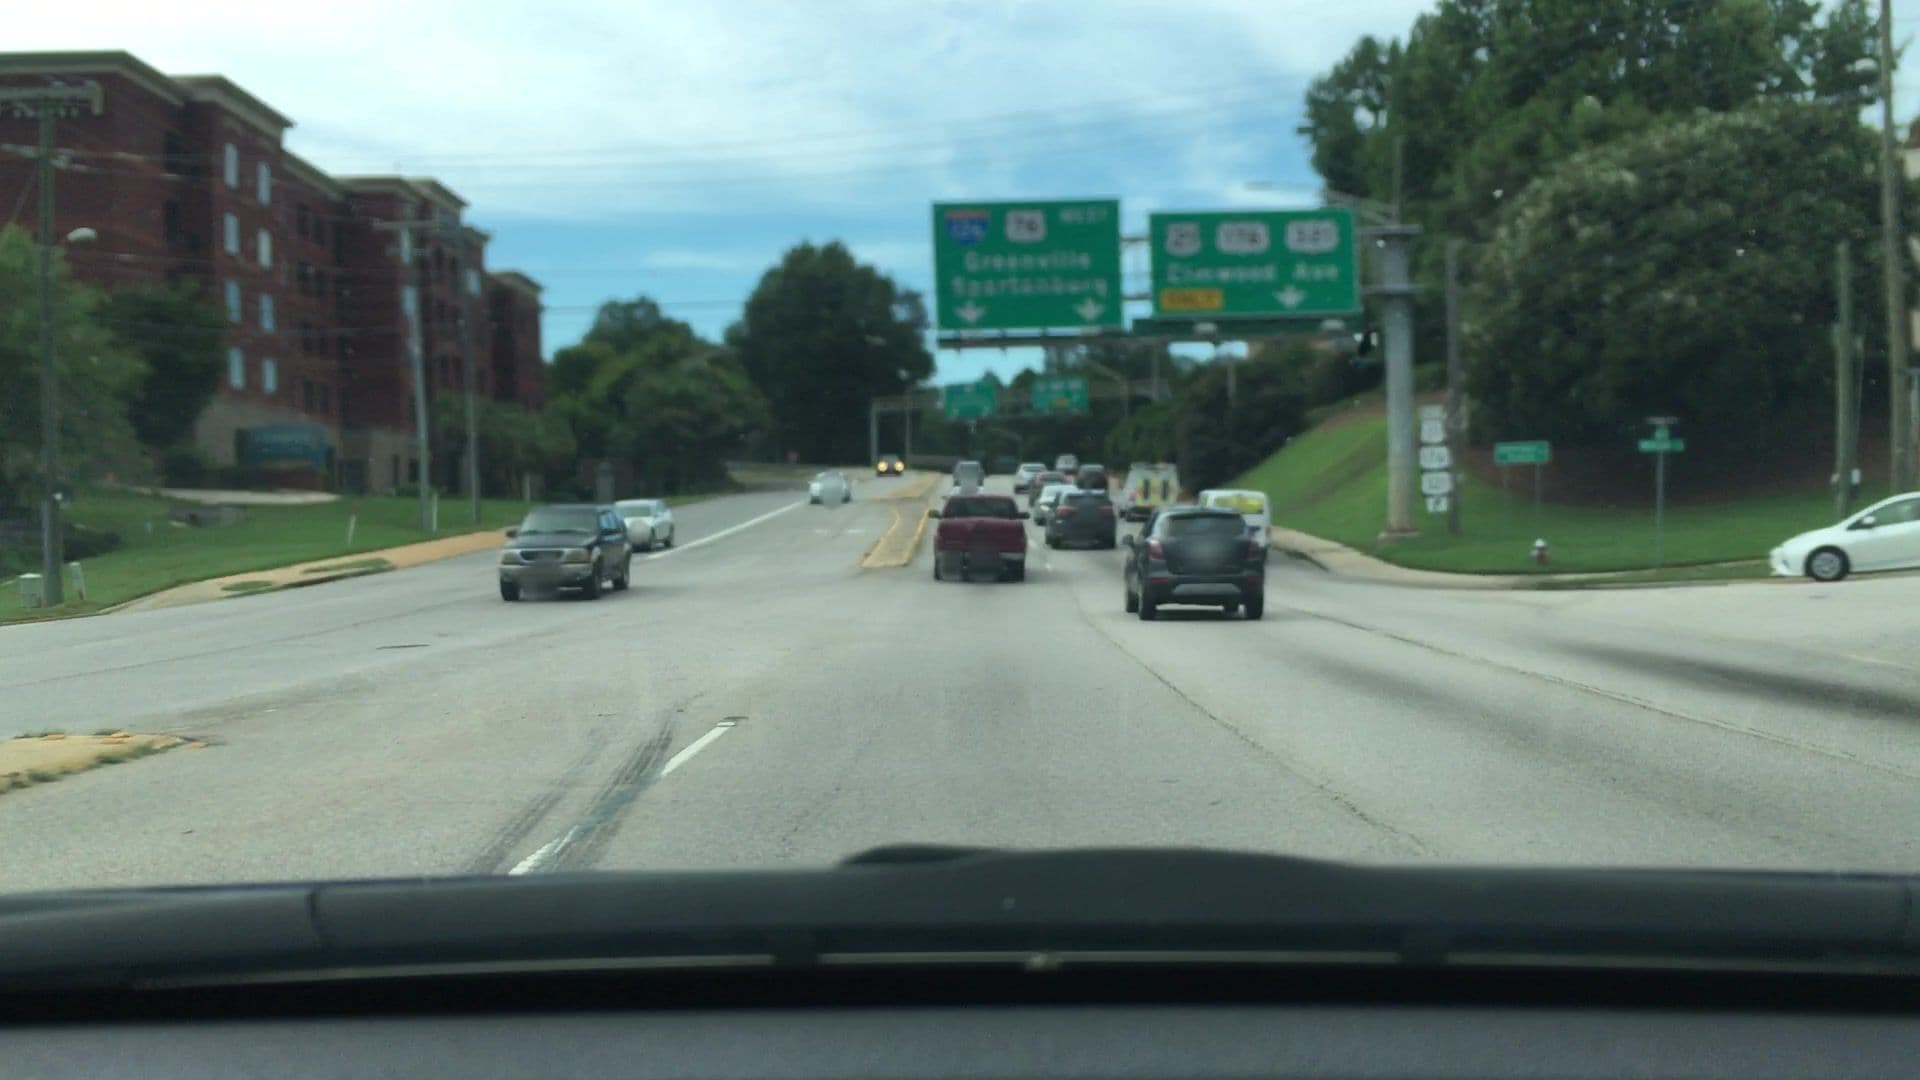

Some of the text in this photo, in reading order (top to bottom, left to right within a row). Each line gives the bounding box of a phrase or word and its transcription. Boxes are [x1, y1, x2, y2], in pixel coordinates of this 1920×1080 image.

[1012, 217, 1039, 233] 76
[964, 250, 1091, 271] Greenville
[1292, 261, 1339, 281] Ave
[952, 274, 1107, 296] Spartanburg
